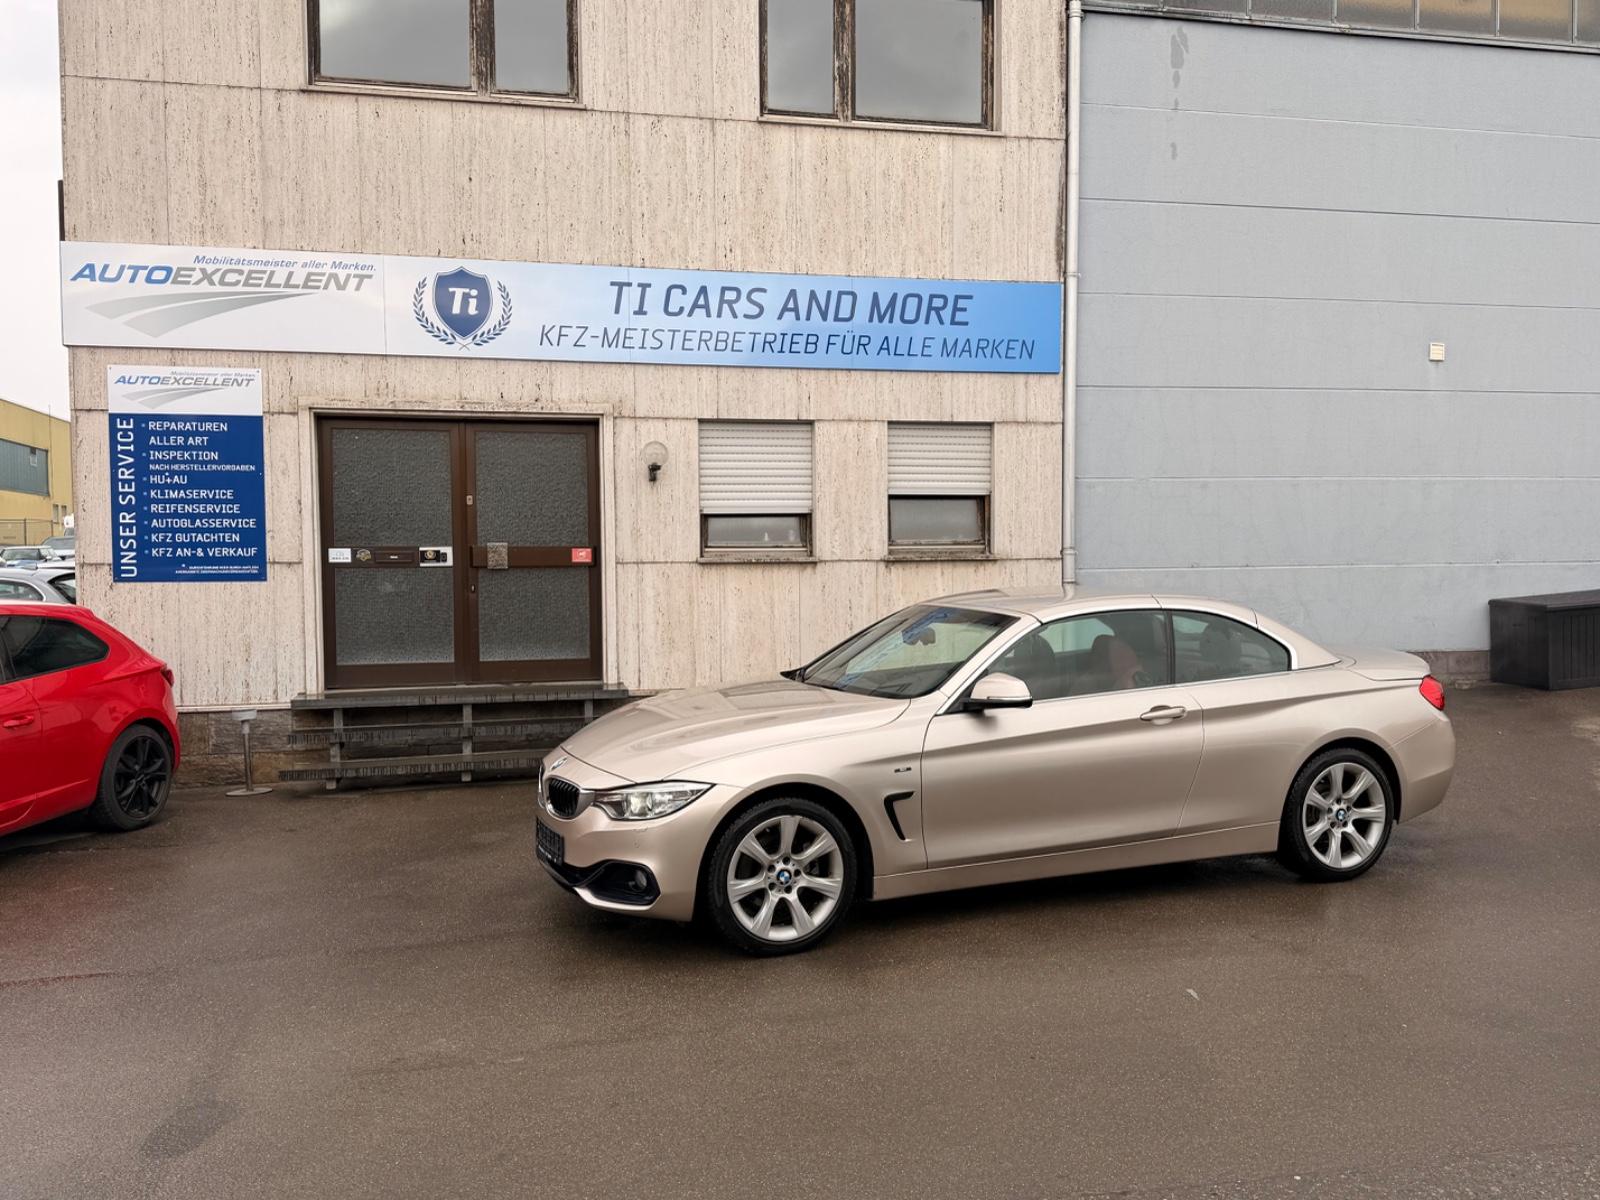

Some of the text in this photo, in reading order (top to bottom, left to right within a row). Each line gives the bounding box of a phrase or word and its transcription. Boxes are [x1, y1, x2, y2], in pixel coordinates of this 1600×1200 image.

[193, 255, 377, 272] Mobilitätsmeister aller Marken.
[70, 263, 374, 291] AUTOEXCELLENT
[448, 287, 479, 315] Ti
[610, 281, 974, 327] TI CARS AND MORE
[539, 325, 1035, 361] KFZ-MEISTERBETRIEB FÜR ALLE MARKEN
[114, 375, 255, 388] AUTOEXCELLENT
[148, 421, 228, 432] REPARATUREN
[149, 436, 209, 446] ALLER ART
[149, 451, 219, 461] INSPEKTION
[149, 463, 170, 471] NACH
[149, 475, 188, 484] HU+AU
[116, 417, 138, 578] UNSER SERVICE
[150, 489, 234, 499] KLIMASERVICE
[151, 504, 240, 514] REIFENSERVICE
[151, 518, 257, 529] AUTOGLASSERVICE
[151, 533, 240, 542] KFZ GUTACHTEN
[151, 547, 173, 557] KFZ
[207, 547, 258, 557] VERKAUF
